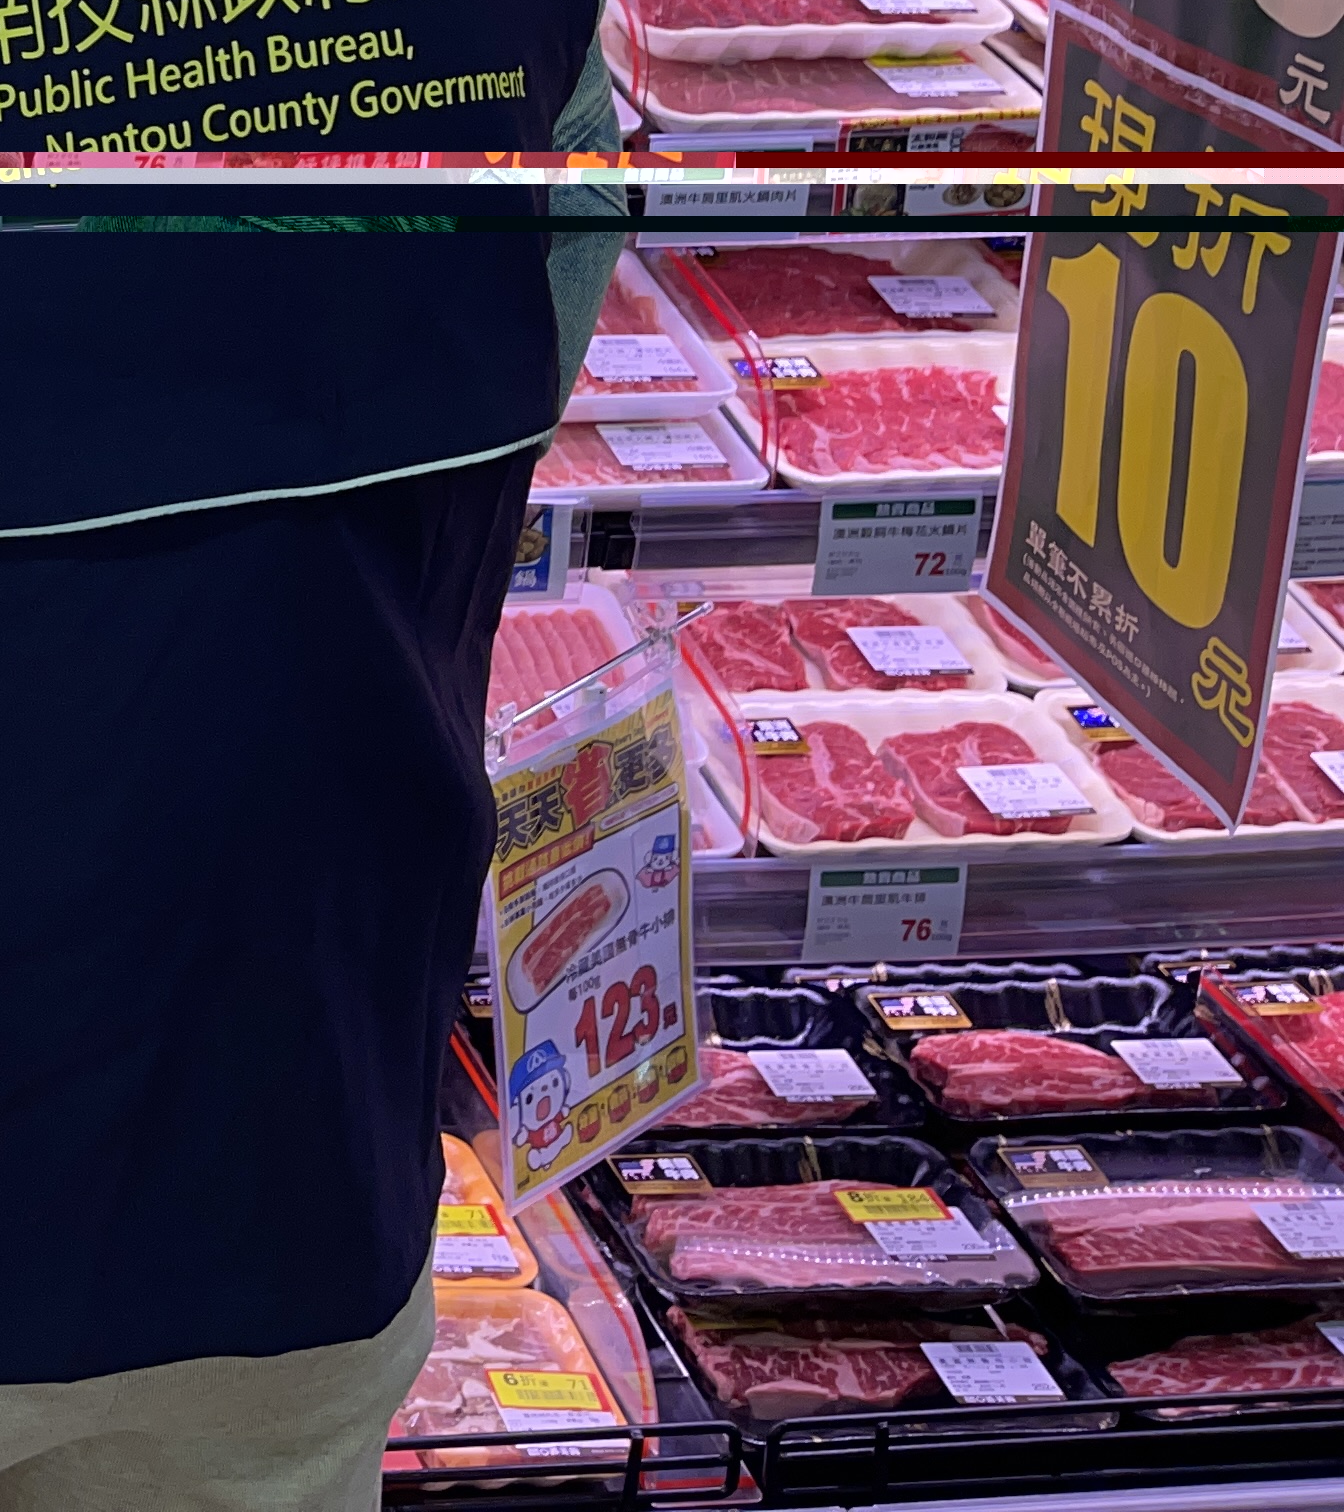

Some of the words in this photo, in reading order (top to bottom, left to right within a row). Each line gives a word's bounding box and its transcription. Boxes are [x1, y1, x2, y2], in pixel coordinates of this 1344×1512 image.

[46, 111, 192, 153] Nantou
[202, 89, 339, 144] County
[349, 65, 526, 119] Government
[125, 41, 257, 102] Health
[268, 28, 414, 75] Bureau,
[1279, 52, 1332, 124] 元
[1046, 243, 1249, 629] 10
[915, 552, 946, 576] 72
[1025, 519, 1140, 643] 單筆不累折
[1193, 637, 1253, 747] 元
[497, 723, 676, 862] 天天省更多
[901, 918, 932, 941] 76
[574, 964, 659, 1079] 123
[662, 1002, 678, 1030] 元
[465, 1208, 488, 1221] 71
